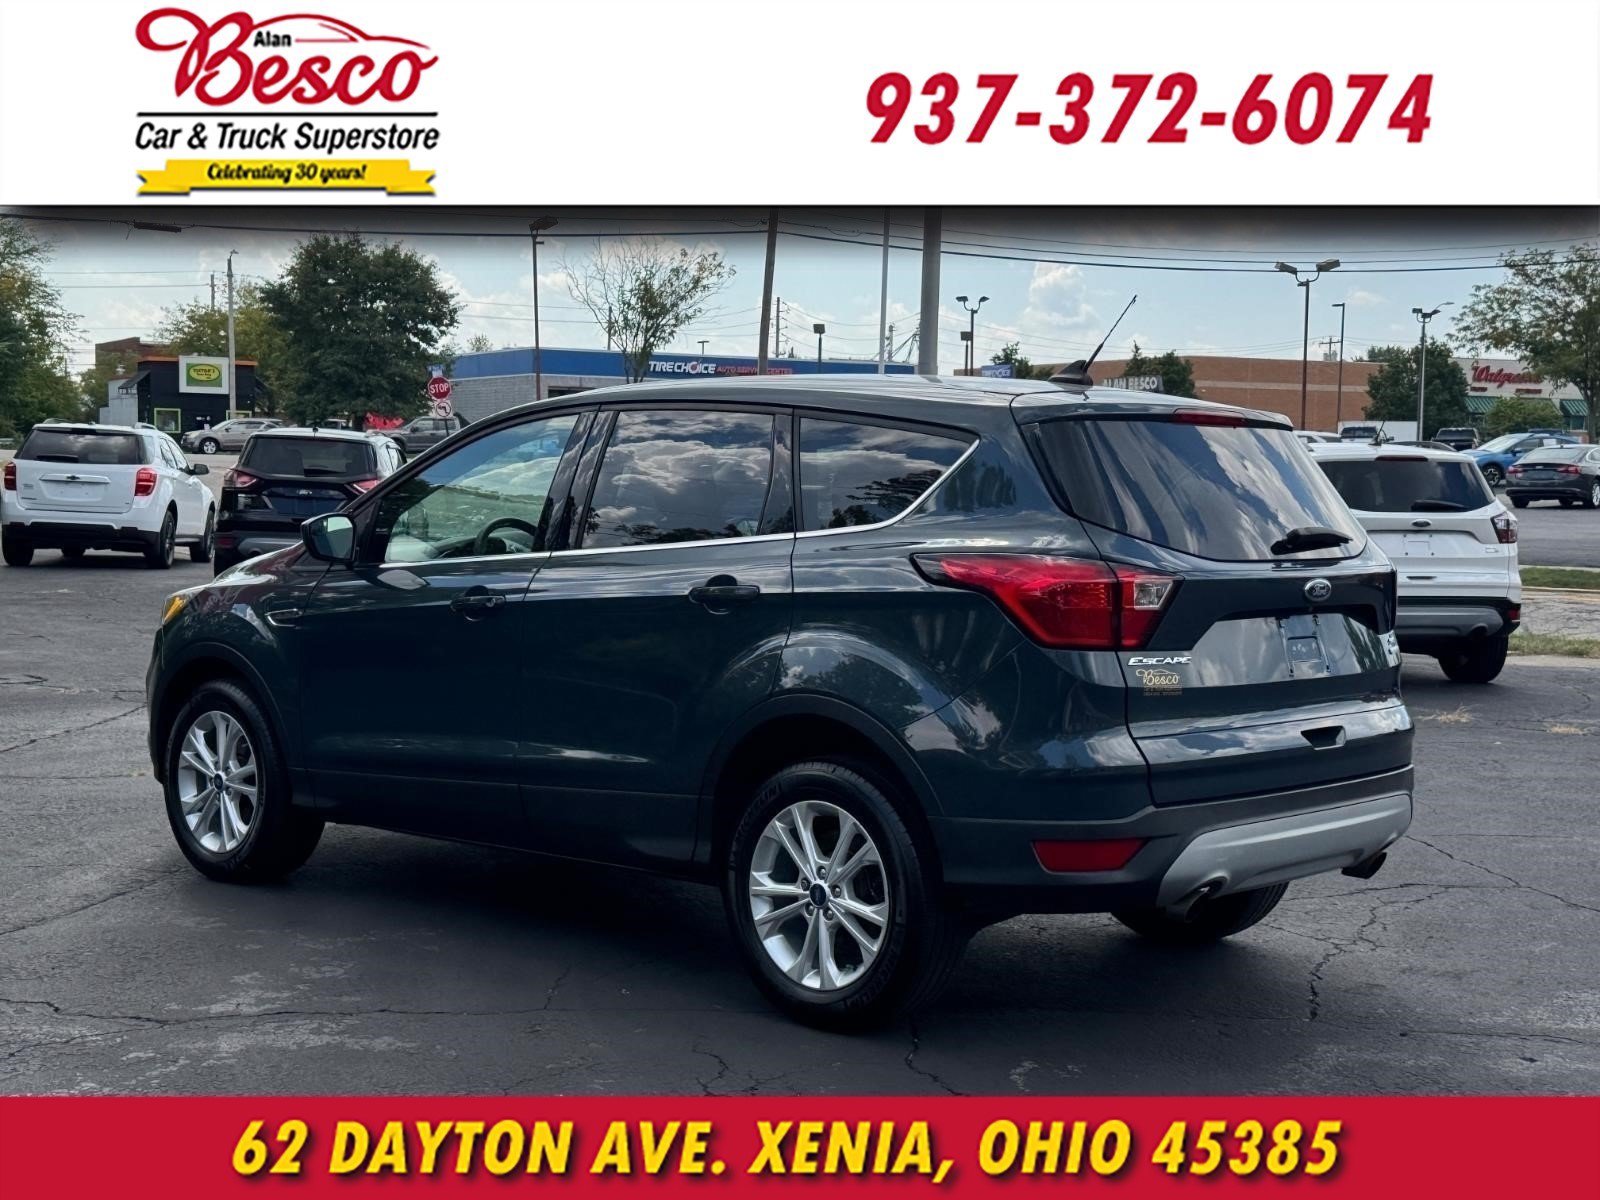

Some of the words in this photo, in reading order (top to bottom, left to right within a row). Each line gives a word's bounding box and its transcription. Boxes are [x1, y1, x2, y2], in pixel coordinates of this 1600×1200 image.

[430, 383, 449, 394] STOP
[1128, 656, 1192, 666] ESCAPE
[1136, 669, 1179, 685] Besco
